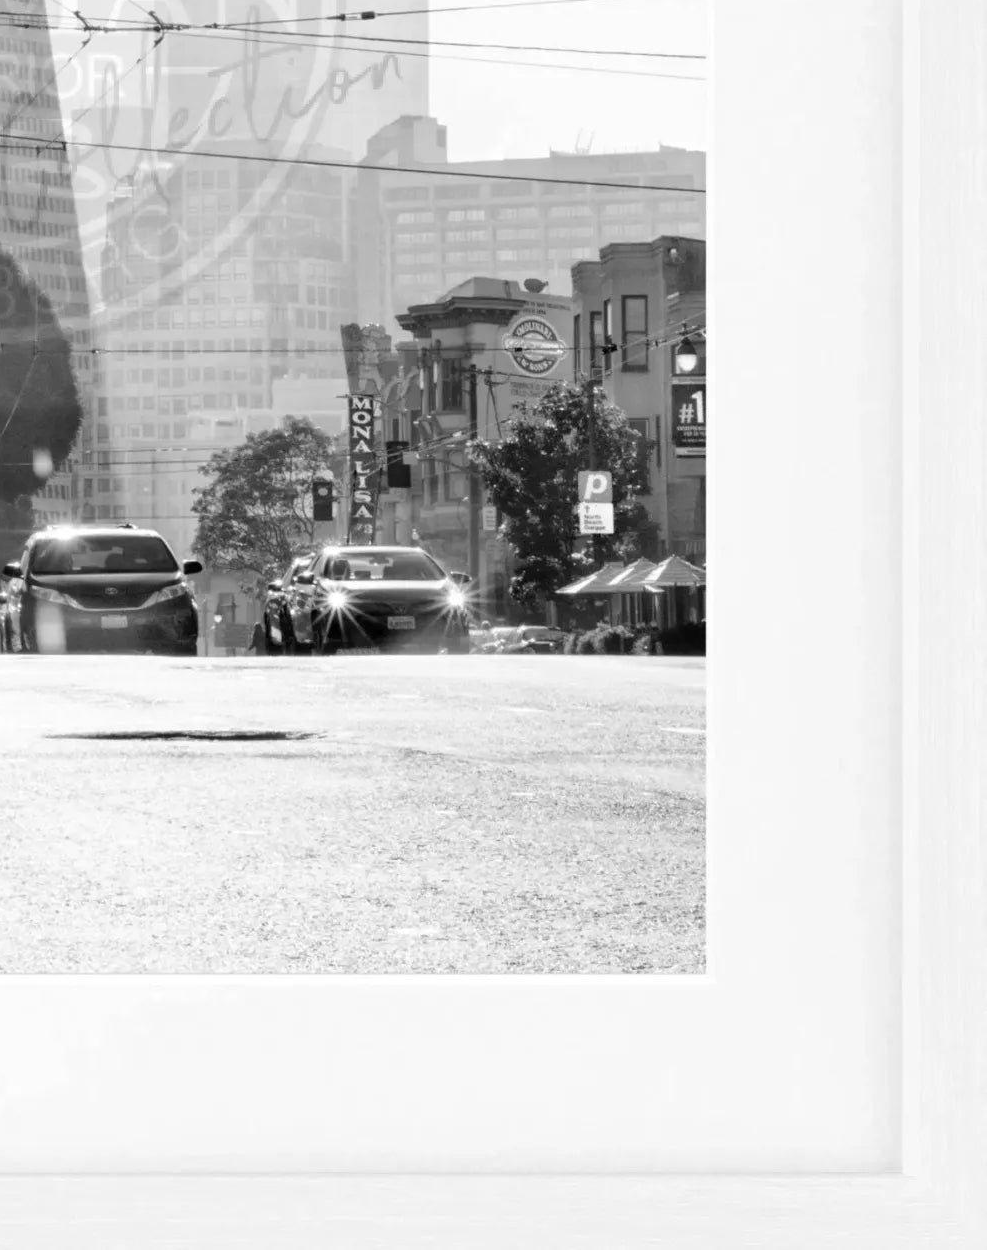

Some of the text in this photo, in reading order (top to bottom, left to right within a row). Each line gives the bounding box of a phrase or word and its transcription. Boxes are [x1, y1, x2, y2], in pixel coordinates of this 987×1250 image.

[678, 390, 704, 424] #1
[352, 398, 371, 453] MONA
[583, 474, 608, 500] P
